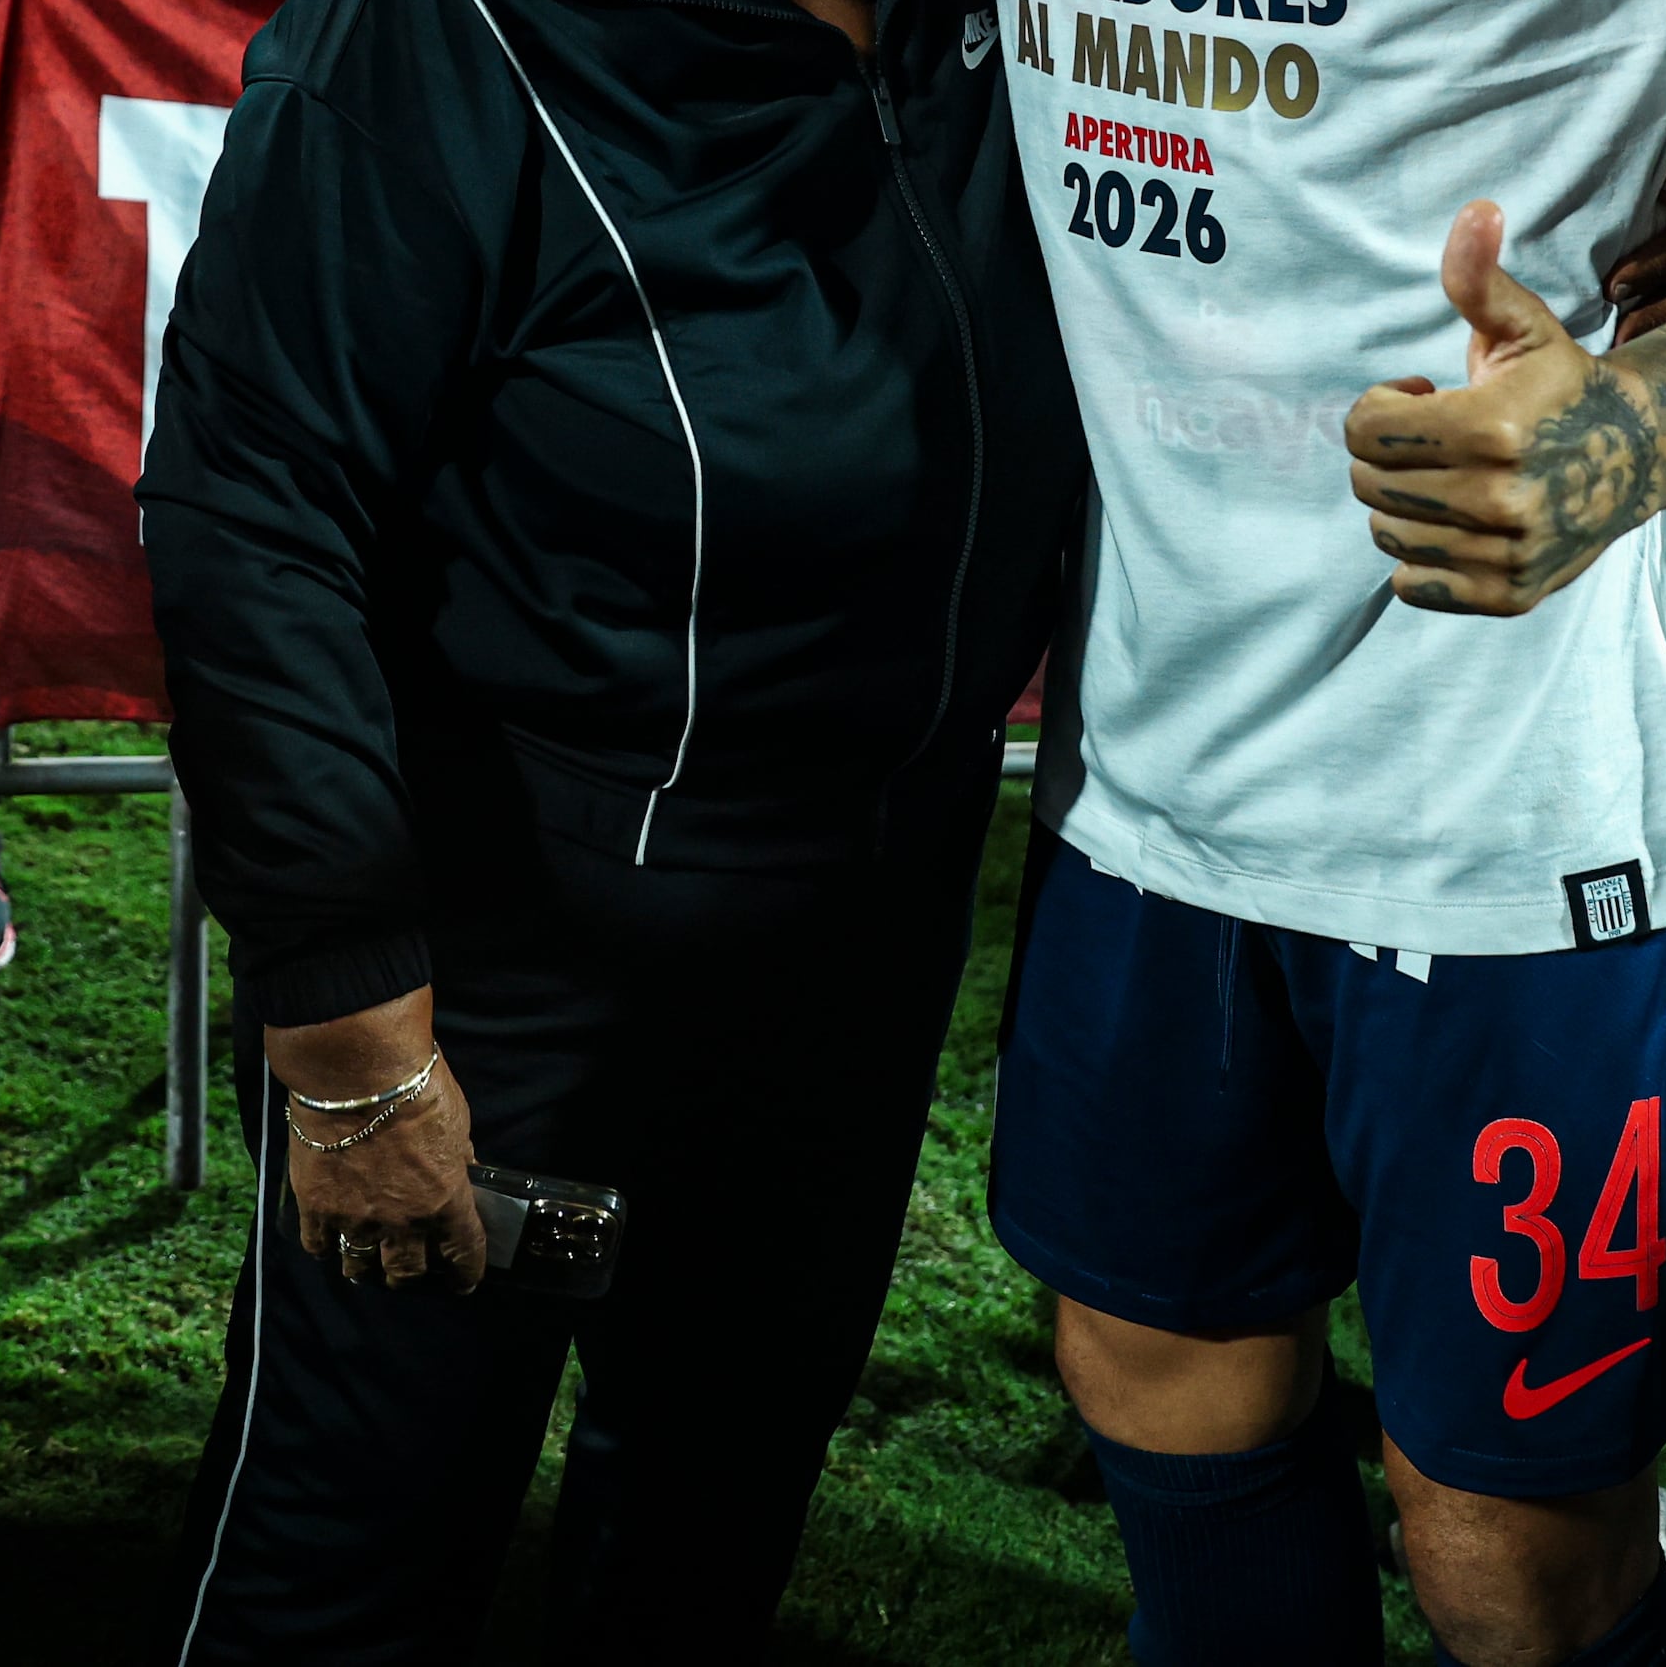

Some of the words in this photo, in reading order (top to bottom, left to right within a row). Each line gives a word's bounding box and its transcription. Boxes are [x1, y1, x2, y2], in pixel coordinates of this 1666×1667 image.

[1071, 11, 1320, 121] MANDO
[1064, 111, 1214, 177] APERTURA
[1063, 162, 1227, 265] 2026
[1587, 876, 1624, 891] ALIANZA
[1469, 1095, 1666, 1333] 34
